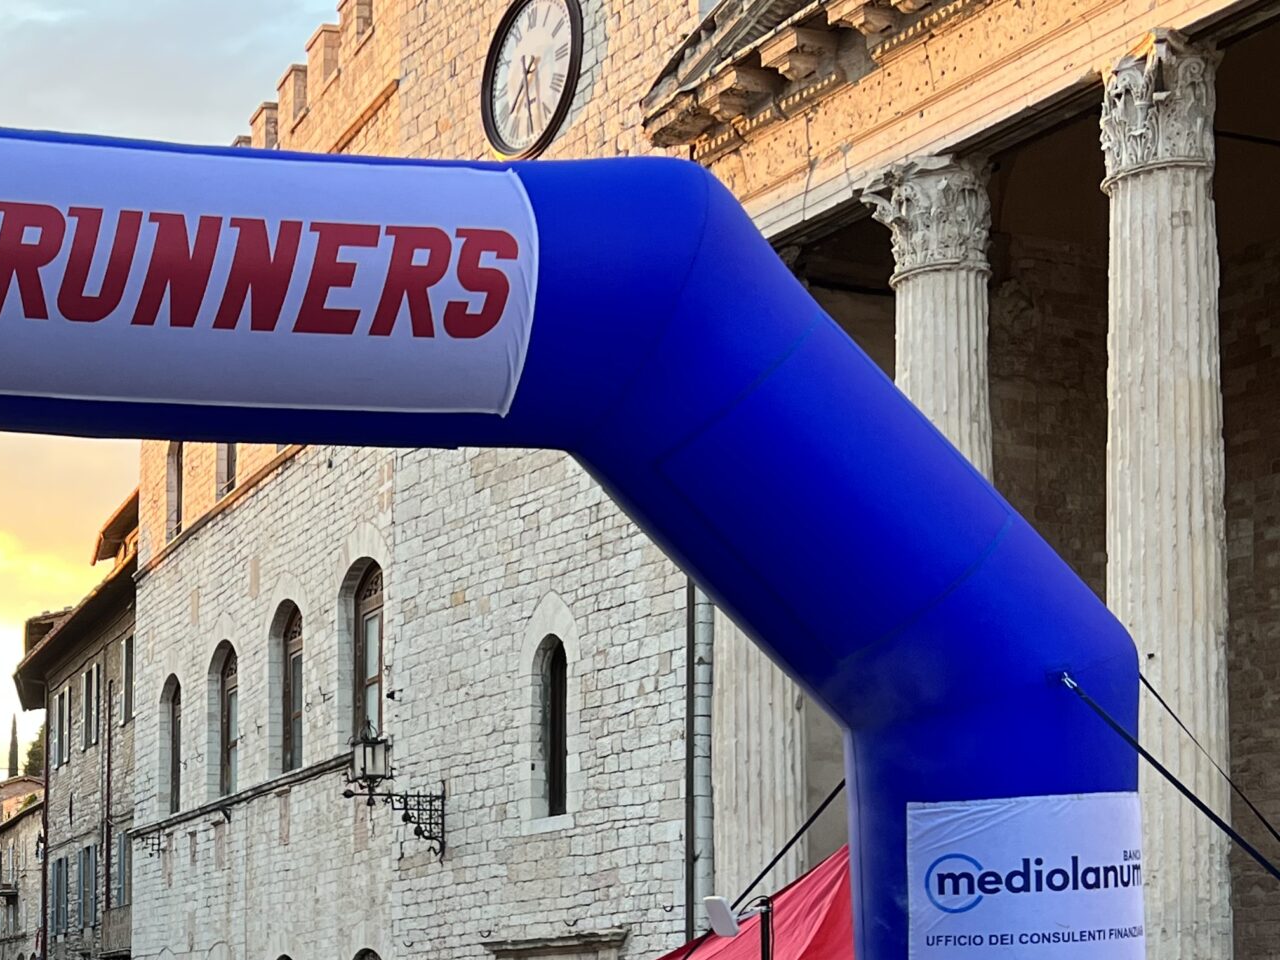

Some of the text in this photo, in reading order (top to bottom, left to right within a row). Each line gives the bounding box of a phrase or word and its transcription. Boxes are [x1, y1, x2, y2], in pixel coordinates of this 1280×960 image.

[937, 855, 1142, 896] mediolanum
[926, 935, 984, 947] UFFICIO
[989, 933, 1014, 946] DEI
[1018, 929, 1106, 944] CONSULENTI
